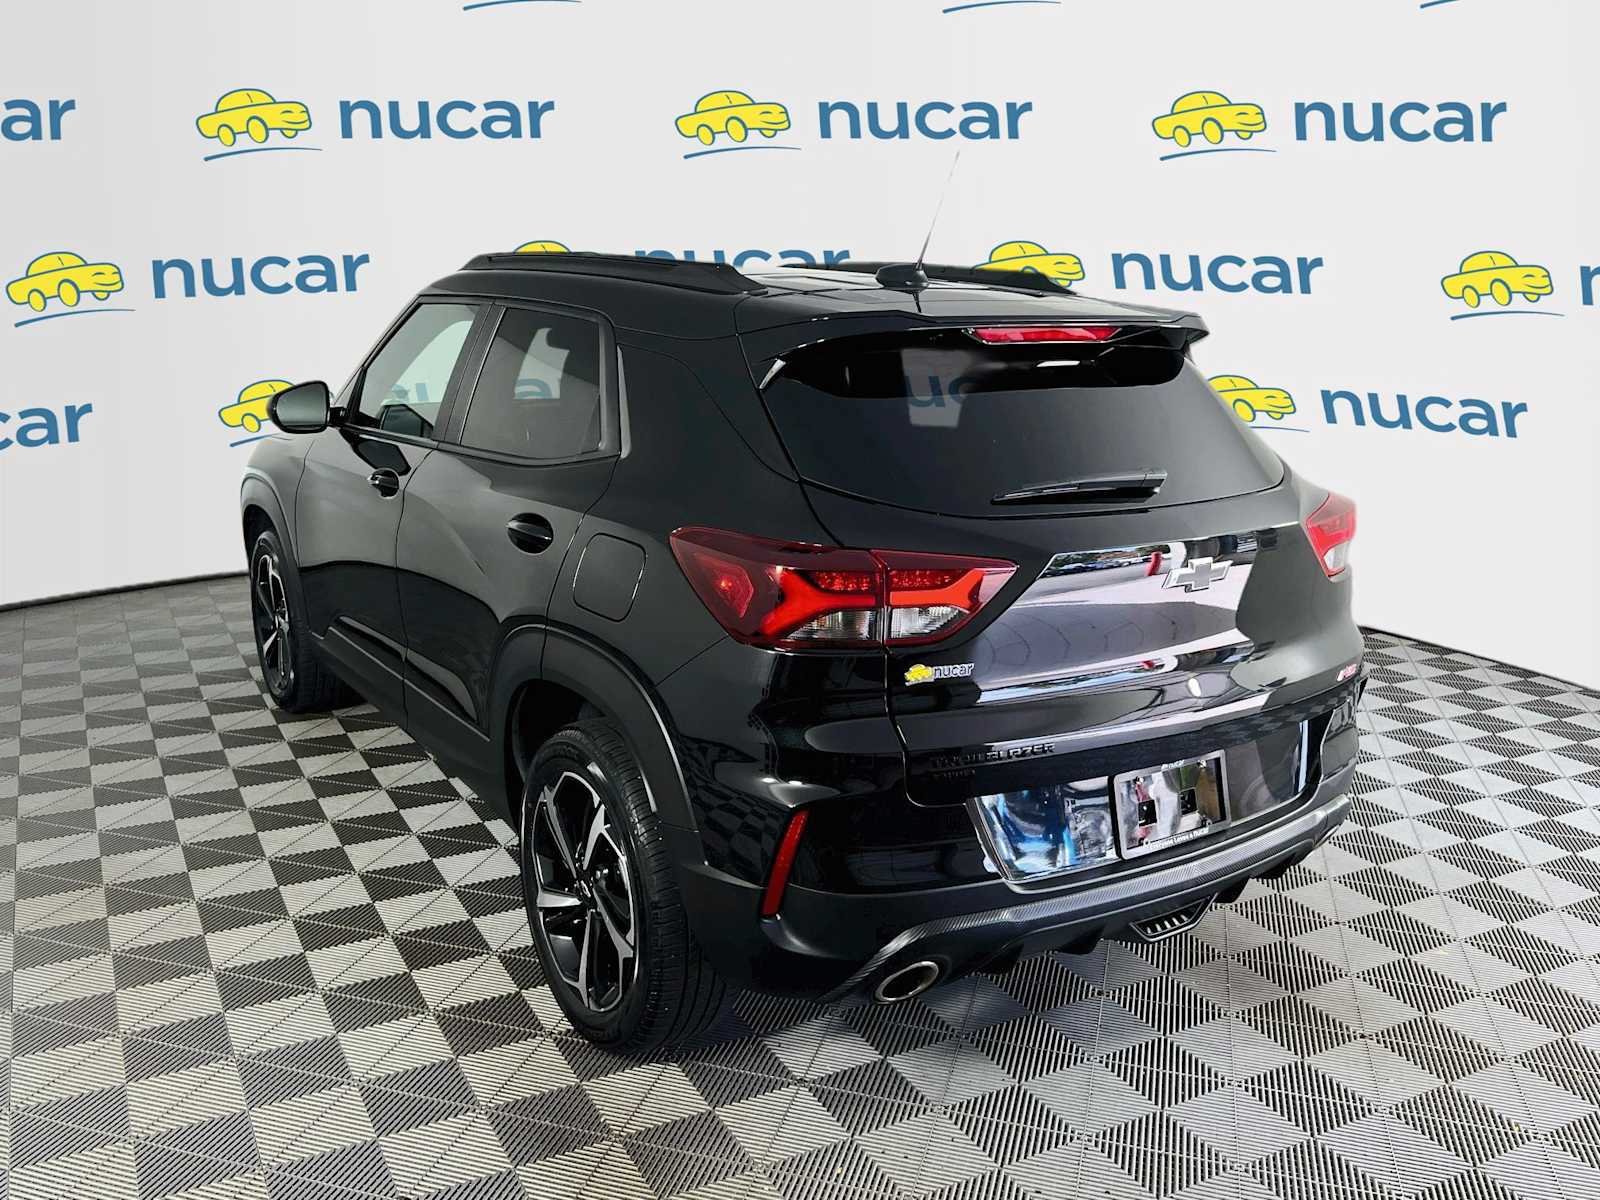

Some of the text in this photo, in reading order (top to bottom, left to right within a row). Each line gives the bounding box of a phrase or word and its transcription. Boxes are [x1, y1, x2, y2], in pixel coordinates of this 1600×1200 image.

[339, 98, 556, 140] nucar
[819, 100, 1033, 141] nucar
[1294, 100, 1508, 143] nucar
[151, 252, 370, 299] nucar
[1111, 251, 1324, 294] nucar
[1320, 388, 1529, 439] nucar
[933, 663, 975, 679] nucar
